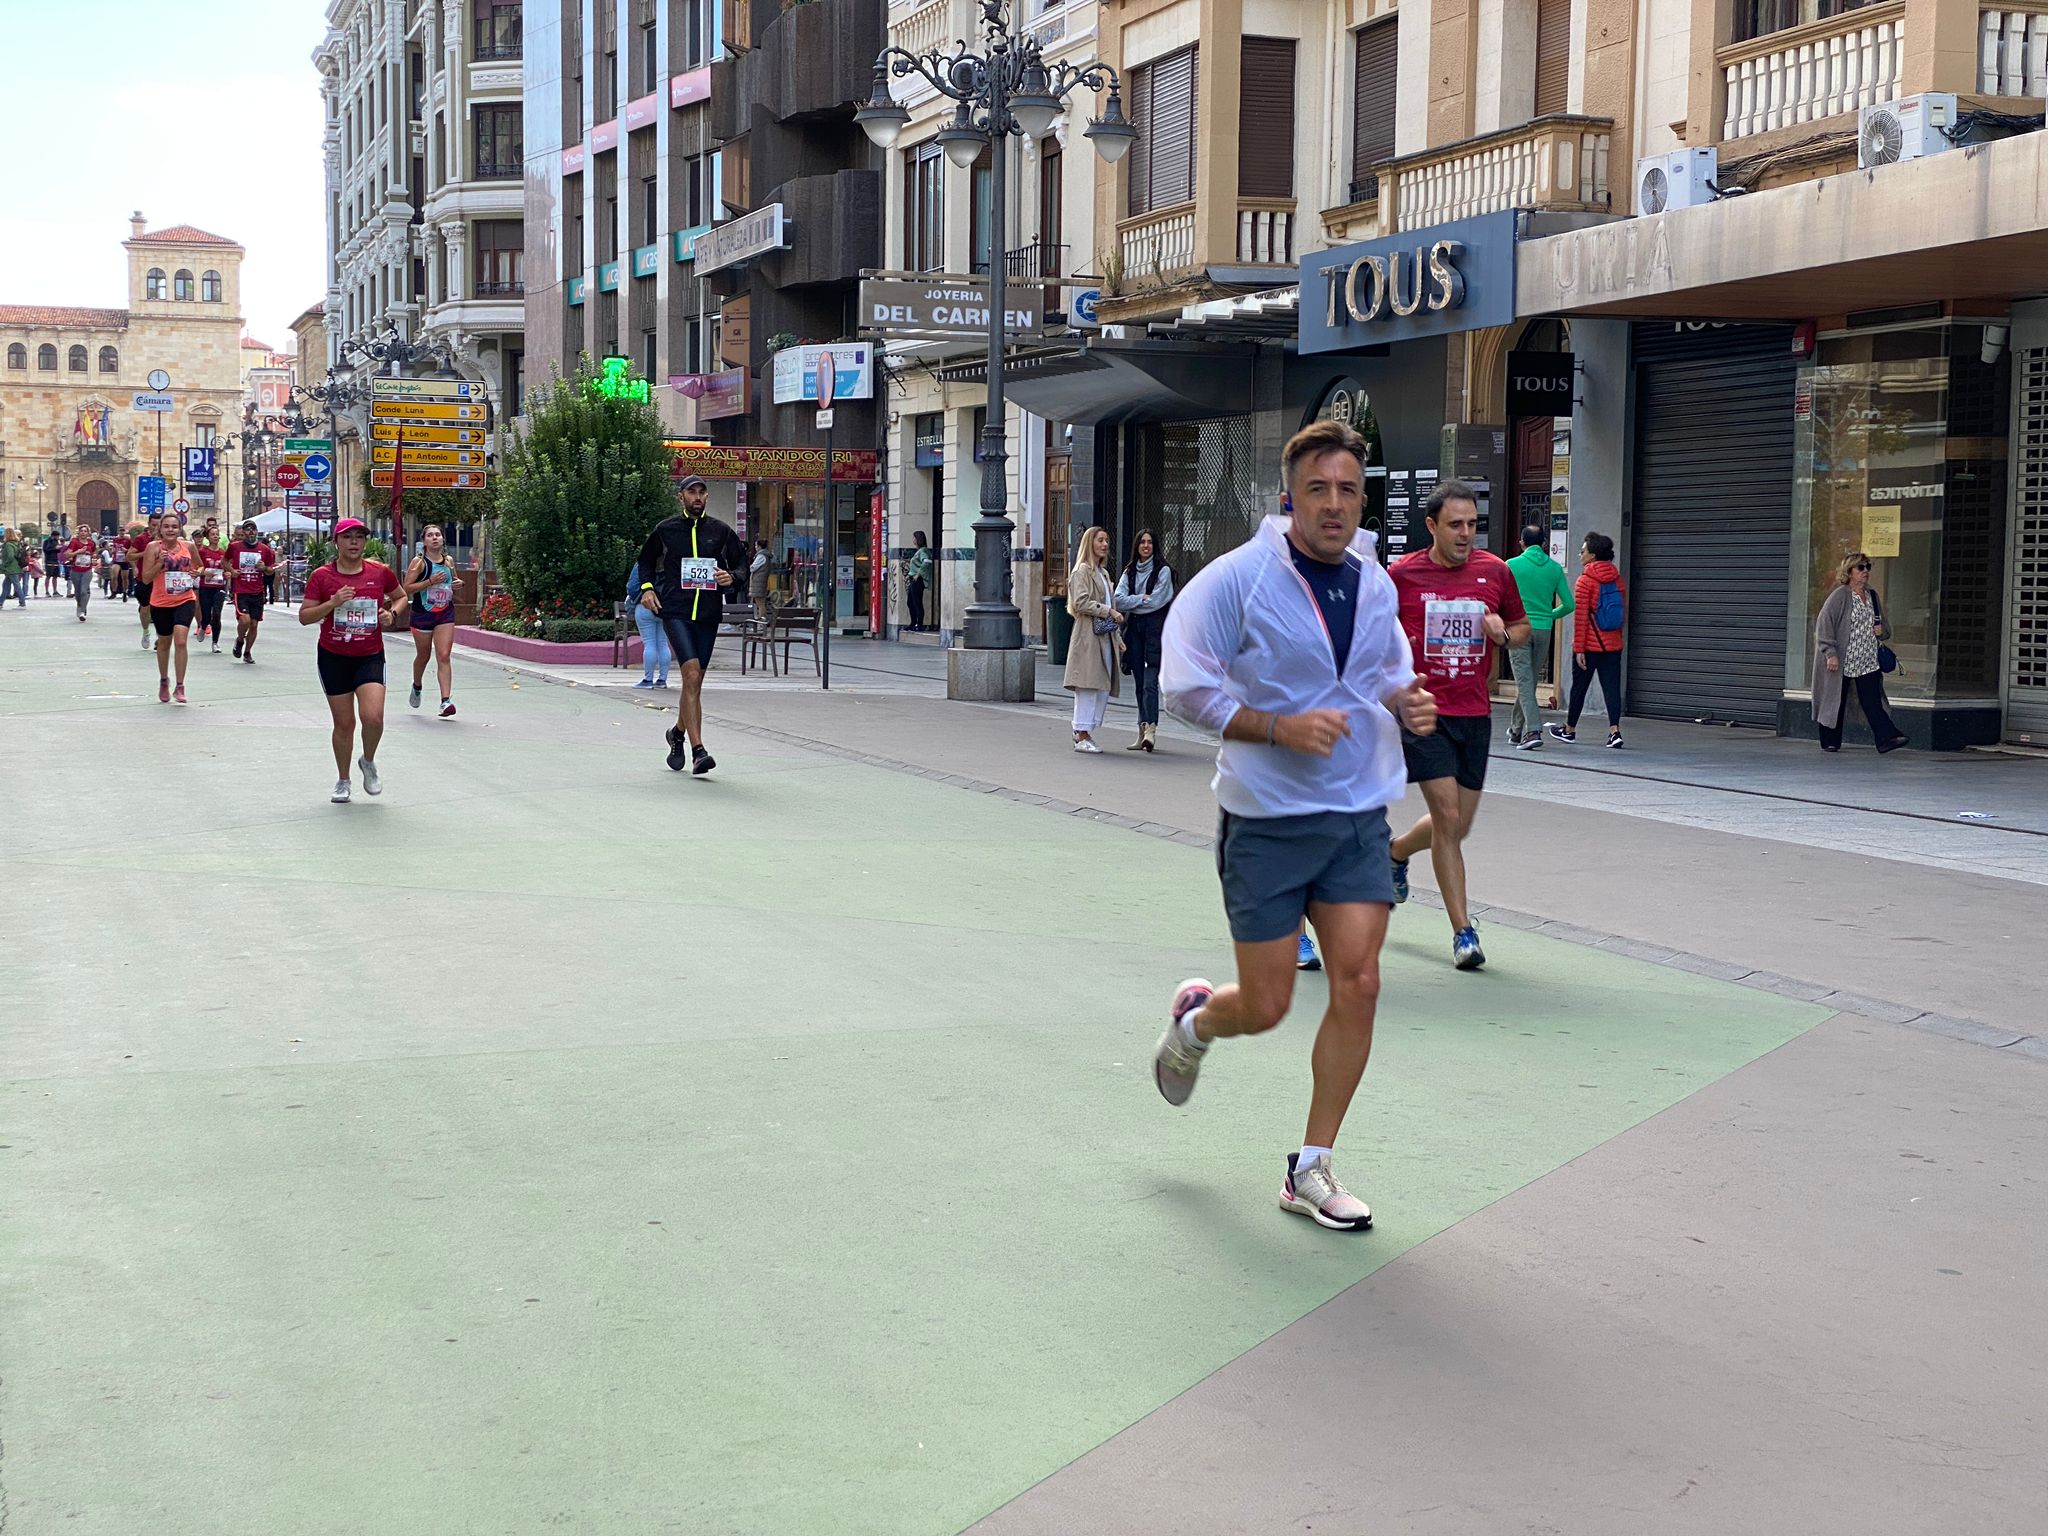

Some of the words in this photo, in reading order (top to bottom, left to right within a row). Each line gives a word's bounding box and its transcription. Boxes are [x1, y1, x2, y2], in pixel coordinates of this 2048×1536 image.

[1319, 240, 1464, 327] TOUS
[924, 289, 984, 301] JOYERIA
[873, 304, 919, 323] DEL
[1513, 376, 1569, 391] TOUS
[375, 428, 392, 436] Luis
[917, 434, 943, 447] ESTRELLA
[375, 451, 392, 459] A.C.
[416, 453, 448, 461] Antonio
[675, 448, 739, 460] ROYAL
[747, 449, 852, 462] TANDOORI
[683, 460, 719, 468] INDIAN
[871, 506, 879, 599] CAFETERIA
[690, 567, 708, 579] 523
[172, 579, 187, 587] 624
[347, 610, 365, 623] 651
[1441, 619, 1472, 638] 288
